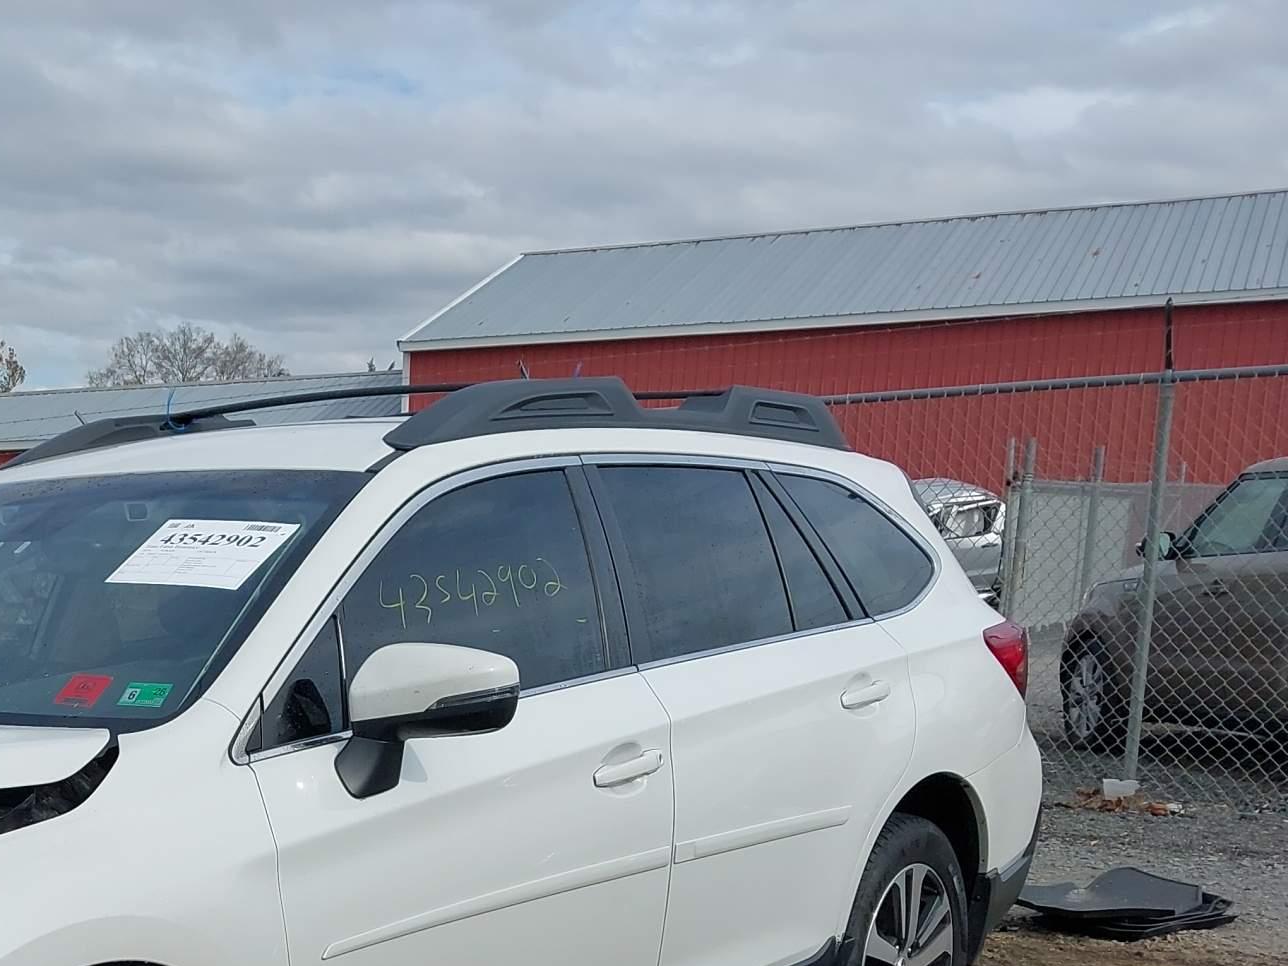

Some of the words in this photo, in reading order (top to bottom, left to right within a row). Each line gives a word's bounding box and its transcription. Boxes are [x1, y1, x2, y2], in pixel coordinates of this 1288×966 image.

[160, 532, 268, 548] 43542902
[379, 557, 569, 630] 43542902
[127, 690, 138, 700] 6
